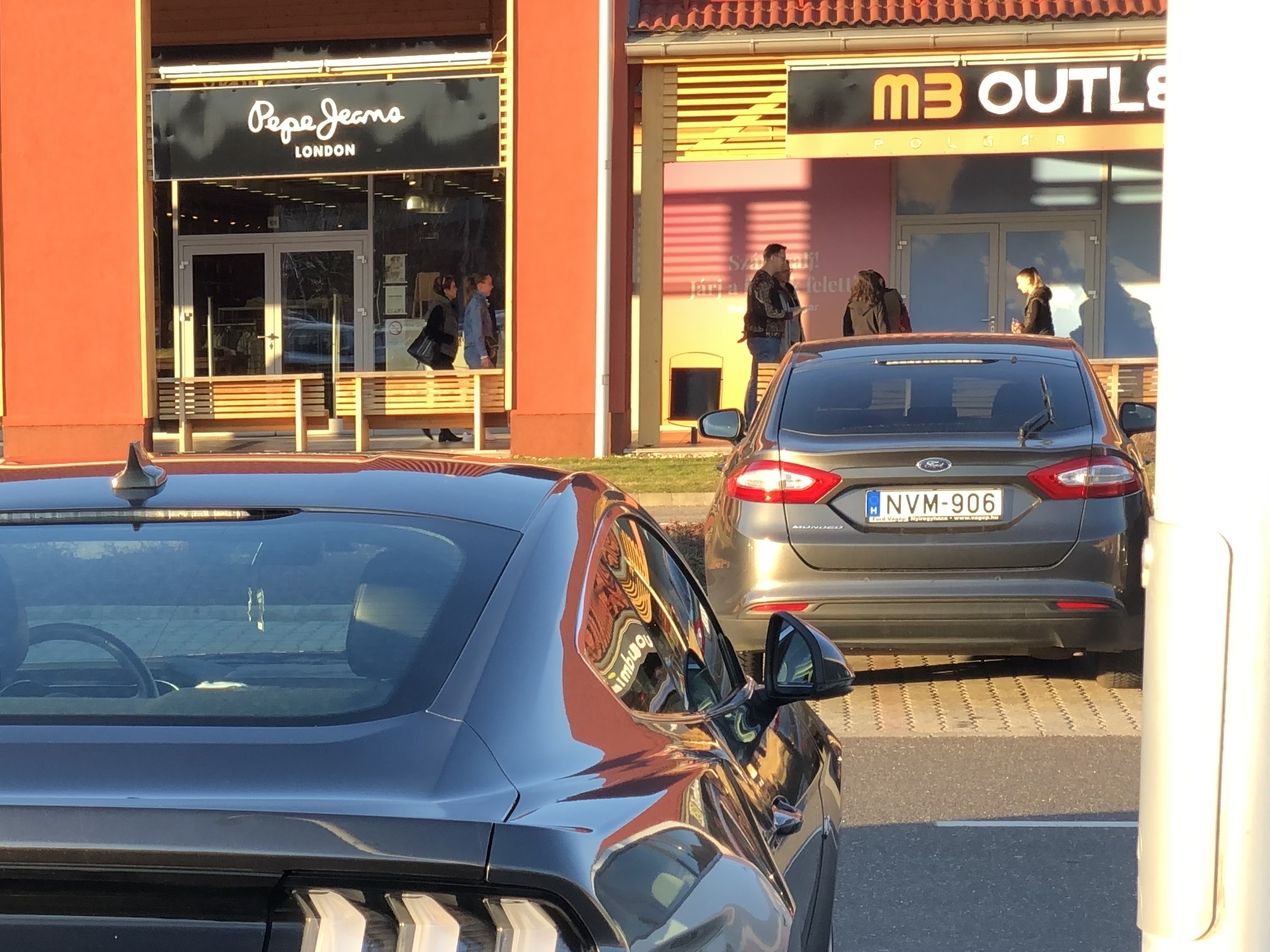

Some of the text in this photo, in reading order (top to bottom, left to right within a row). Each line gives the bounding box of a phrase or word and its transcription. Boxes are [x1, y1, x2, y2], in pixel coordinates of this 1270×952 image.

[248, 97, 405, 145] Pepe Jeans
[295, 143, 356, 159] LONDON
[870, 506, 878, 515] H
[887, 492, 996, 515] NVM-906
